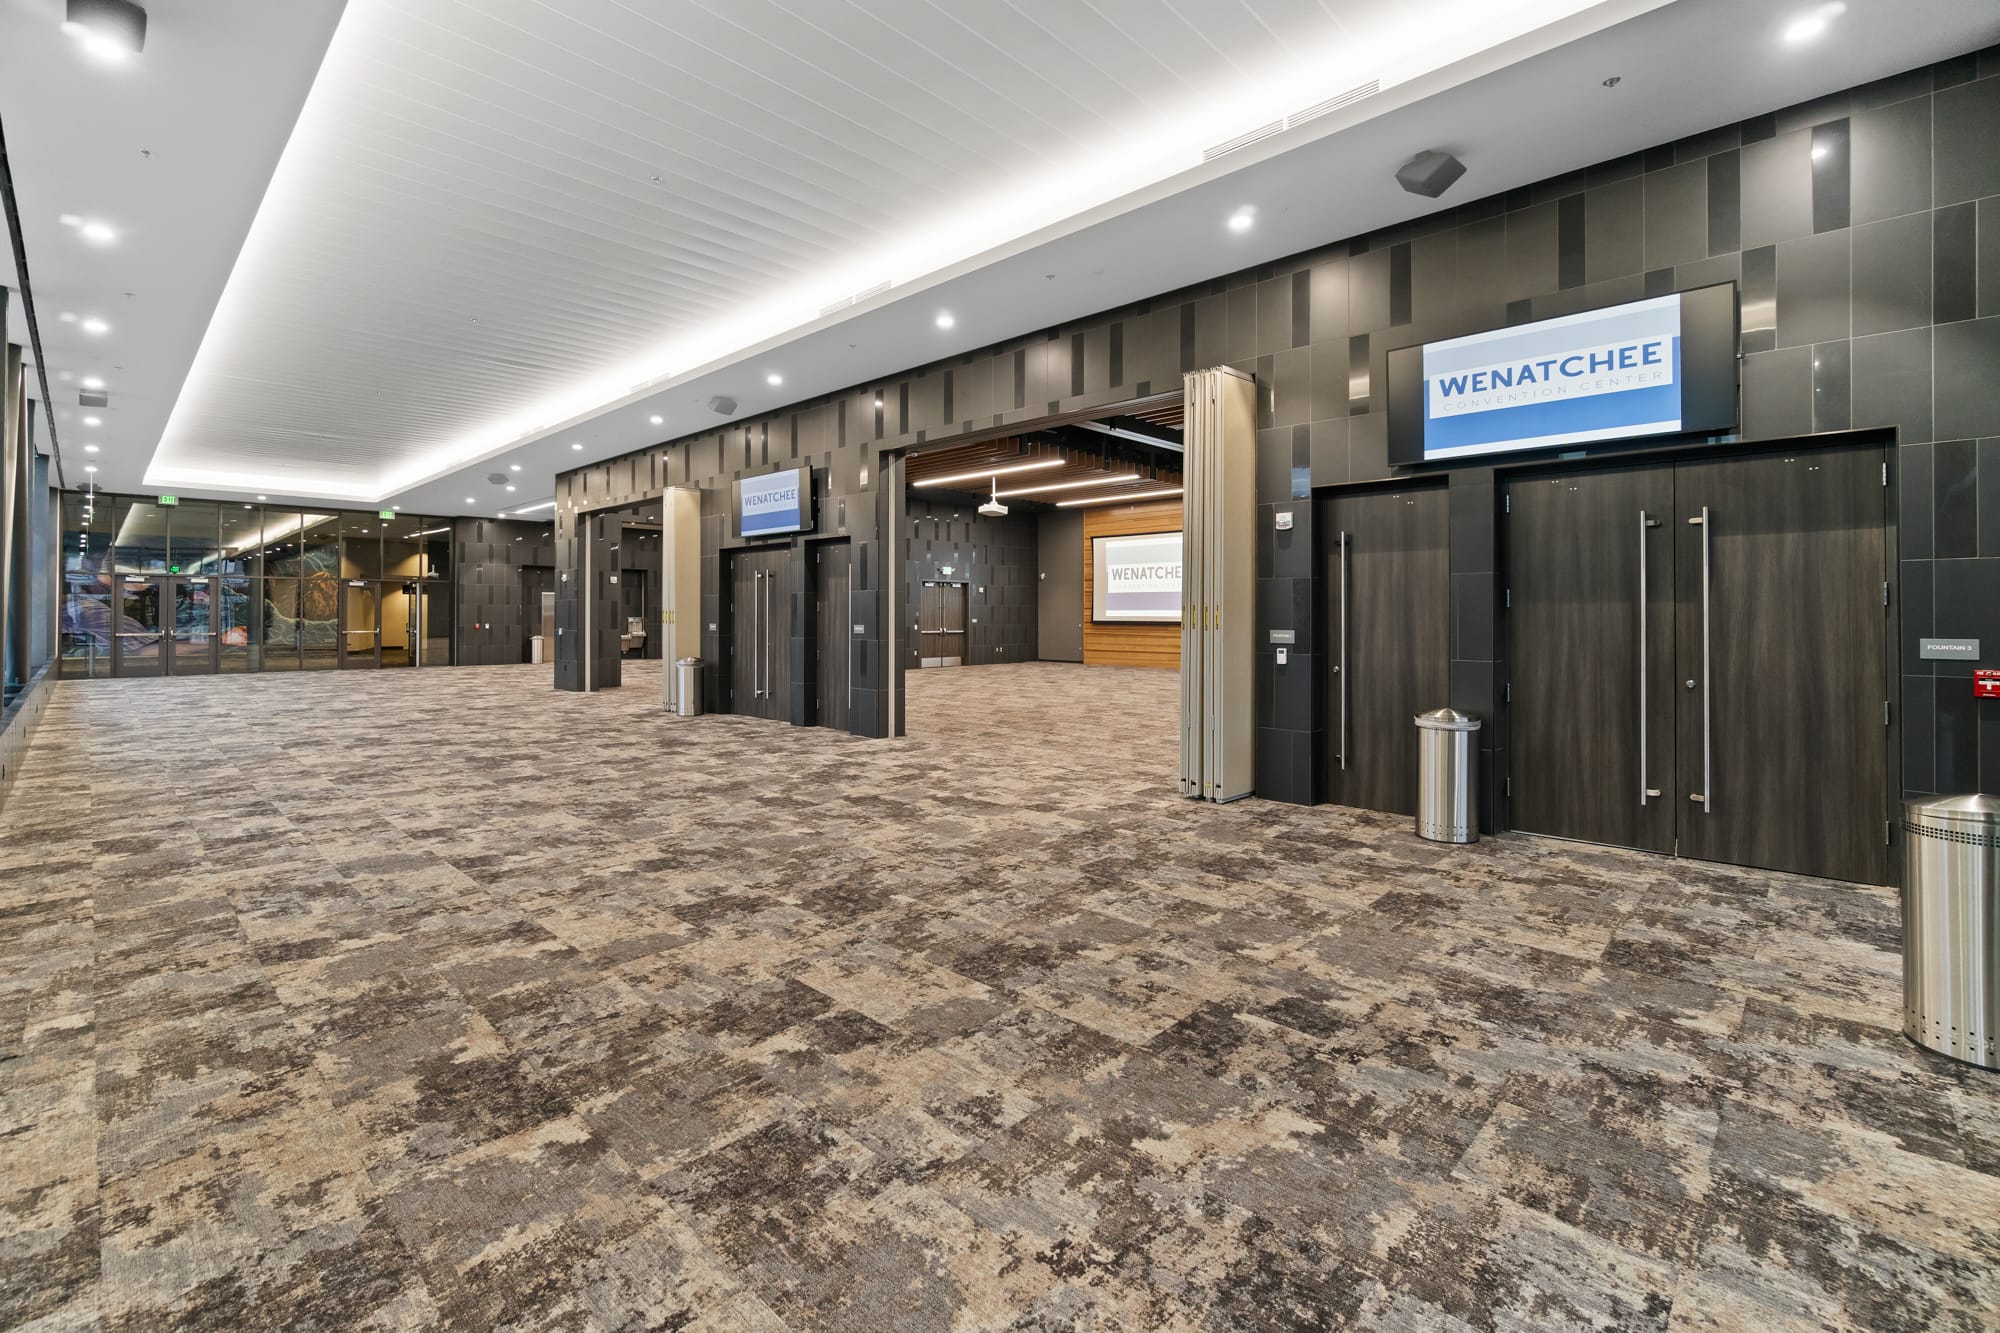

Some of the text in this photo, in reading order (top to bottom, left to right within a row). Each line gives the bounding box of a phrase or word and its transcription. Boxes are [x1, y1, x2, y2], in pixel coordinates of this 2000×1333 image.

[1439, 341, 1662, 397] WENATCHEE
[1443, 371, 1662, 411] CONVENTION CENTER
[161, 496, 175, 504] EXIT
[744, 489, 796, 506] WENATCHEE
